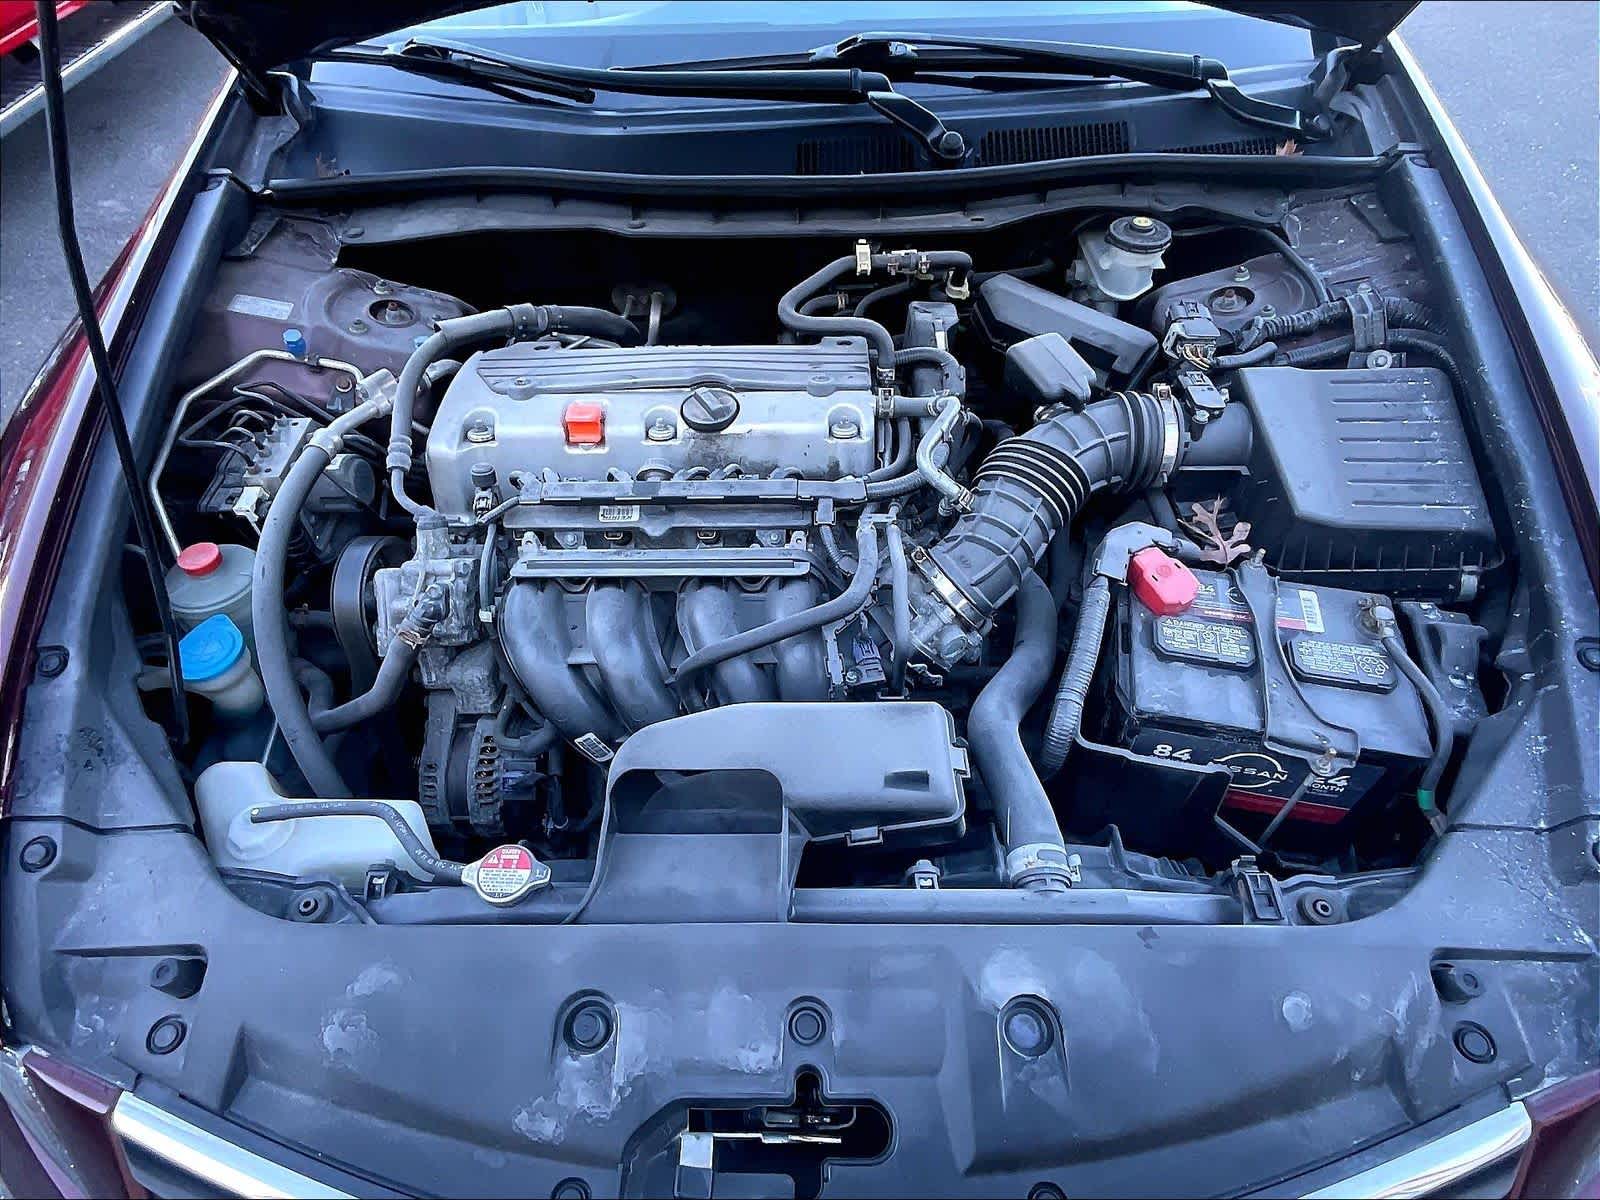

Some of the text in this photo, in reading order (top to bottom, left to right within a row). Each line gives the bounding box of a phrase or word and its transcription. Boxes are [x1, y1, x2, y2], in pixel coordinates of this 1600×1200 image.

[1153, 744, 1193, 761] 84
[1229, 764, 1288, 781] SSAN
[1312, 783, 1345, 793] ONTH
